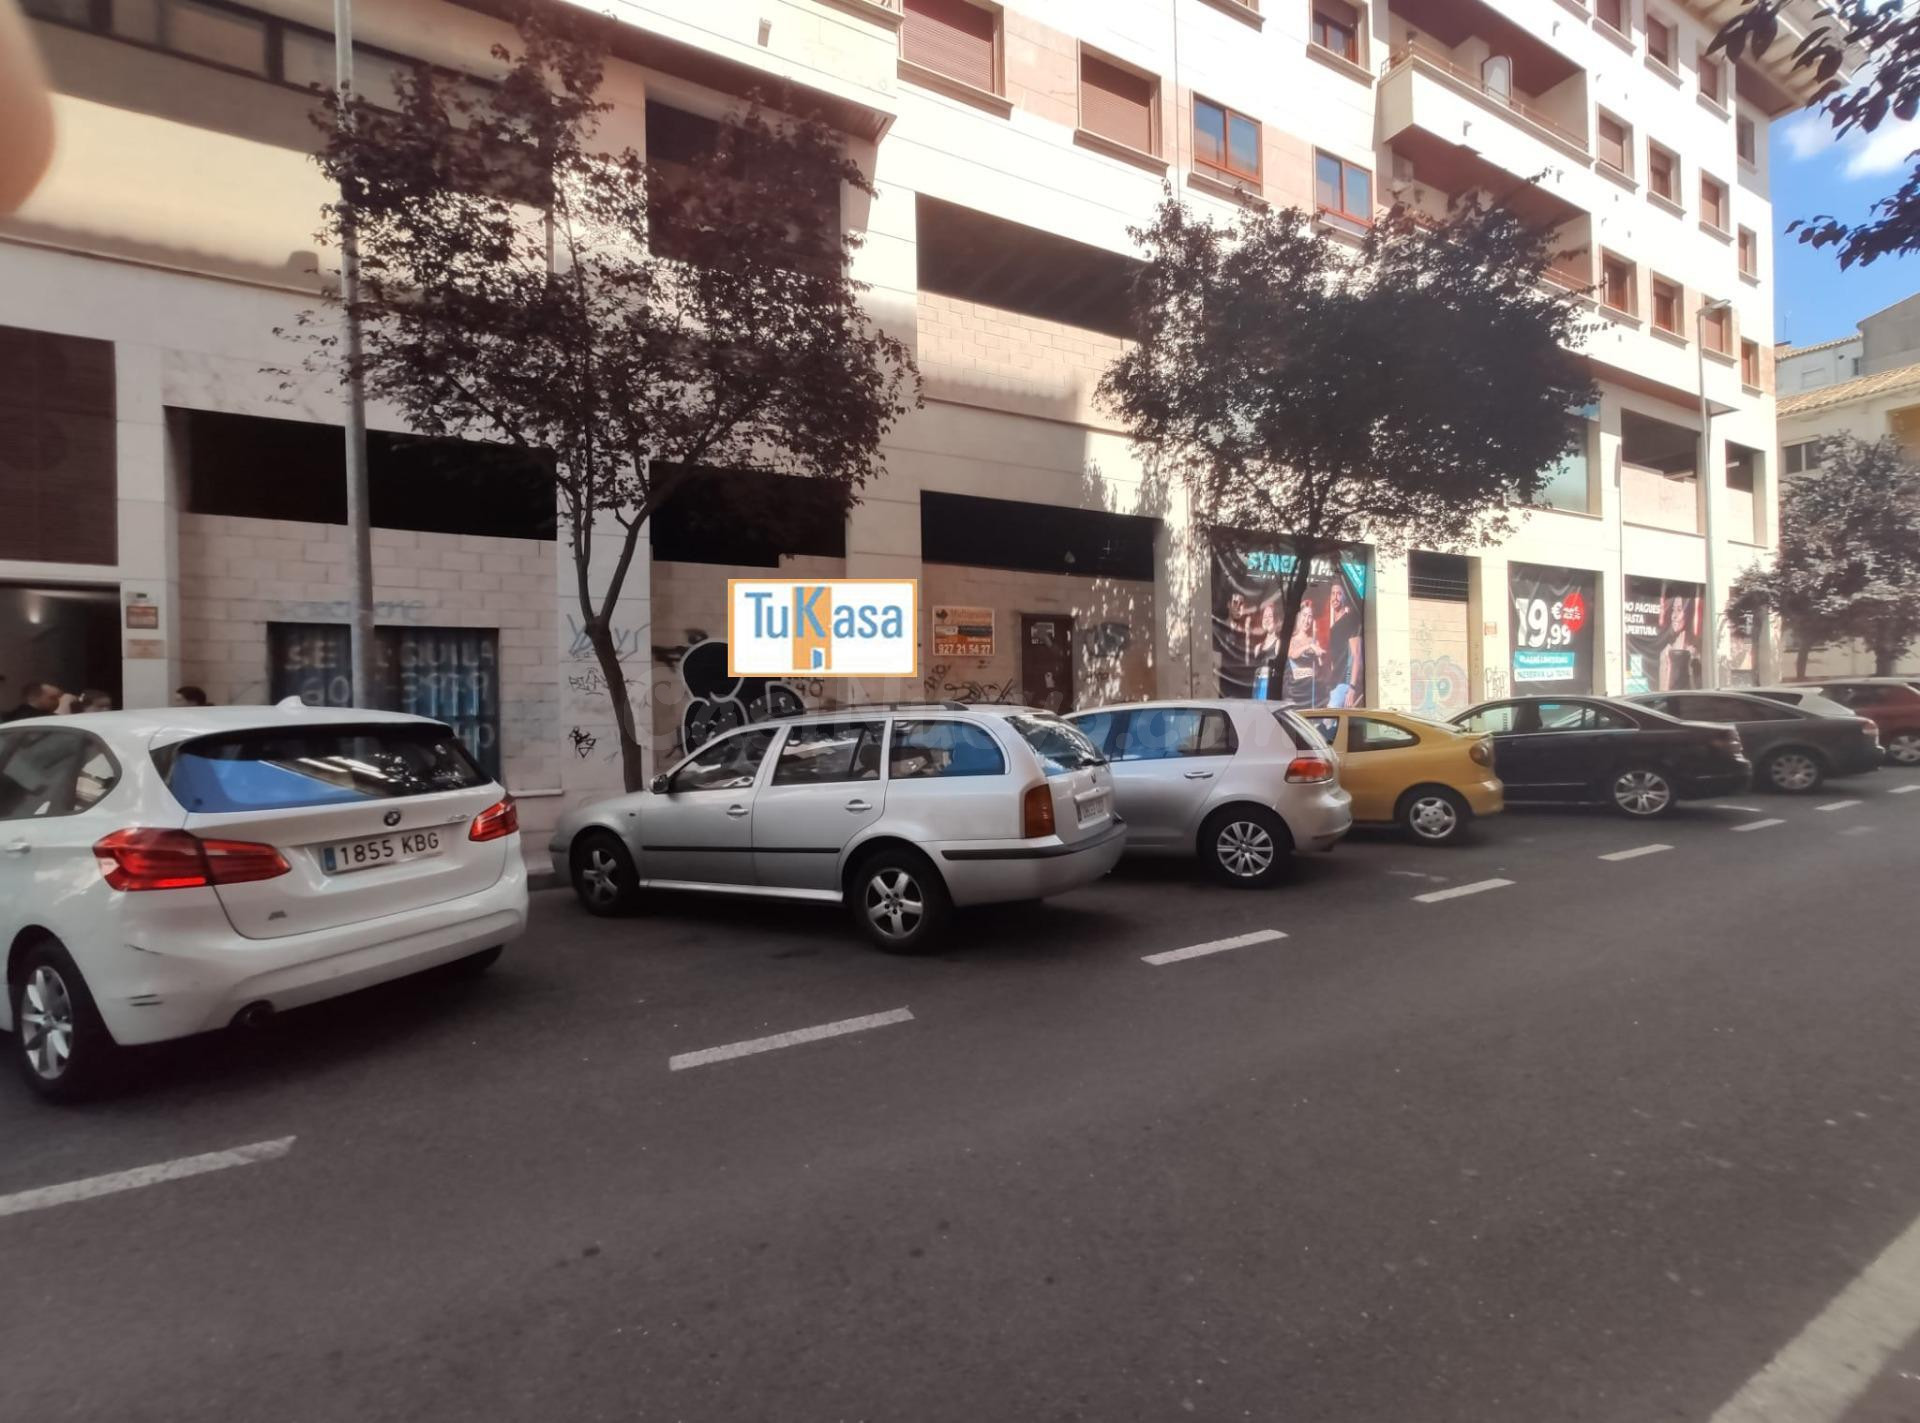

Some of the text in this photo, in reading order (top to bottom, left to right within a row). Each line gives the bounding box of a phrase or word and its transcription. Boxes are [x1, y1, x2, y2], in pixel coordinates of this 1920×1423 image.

[1635, 602, 1661, 614] PAGUES
[938, 643, 954, 655] 927
[340, 832, 439, 865] 1855 KBG
